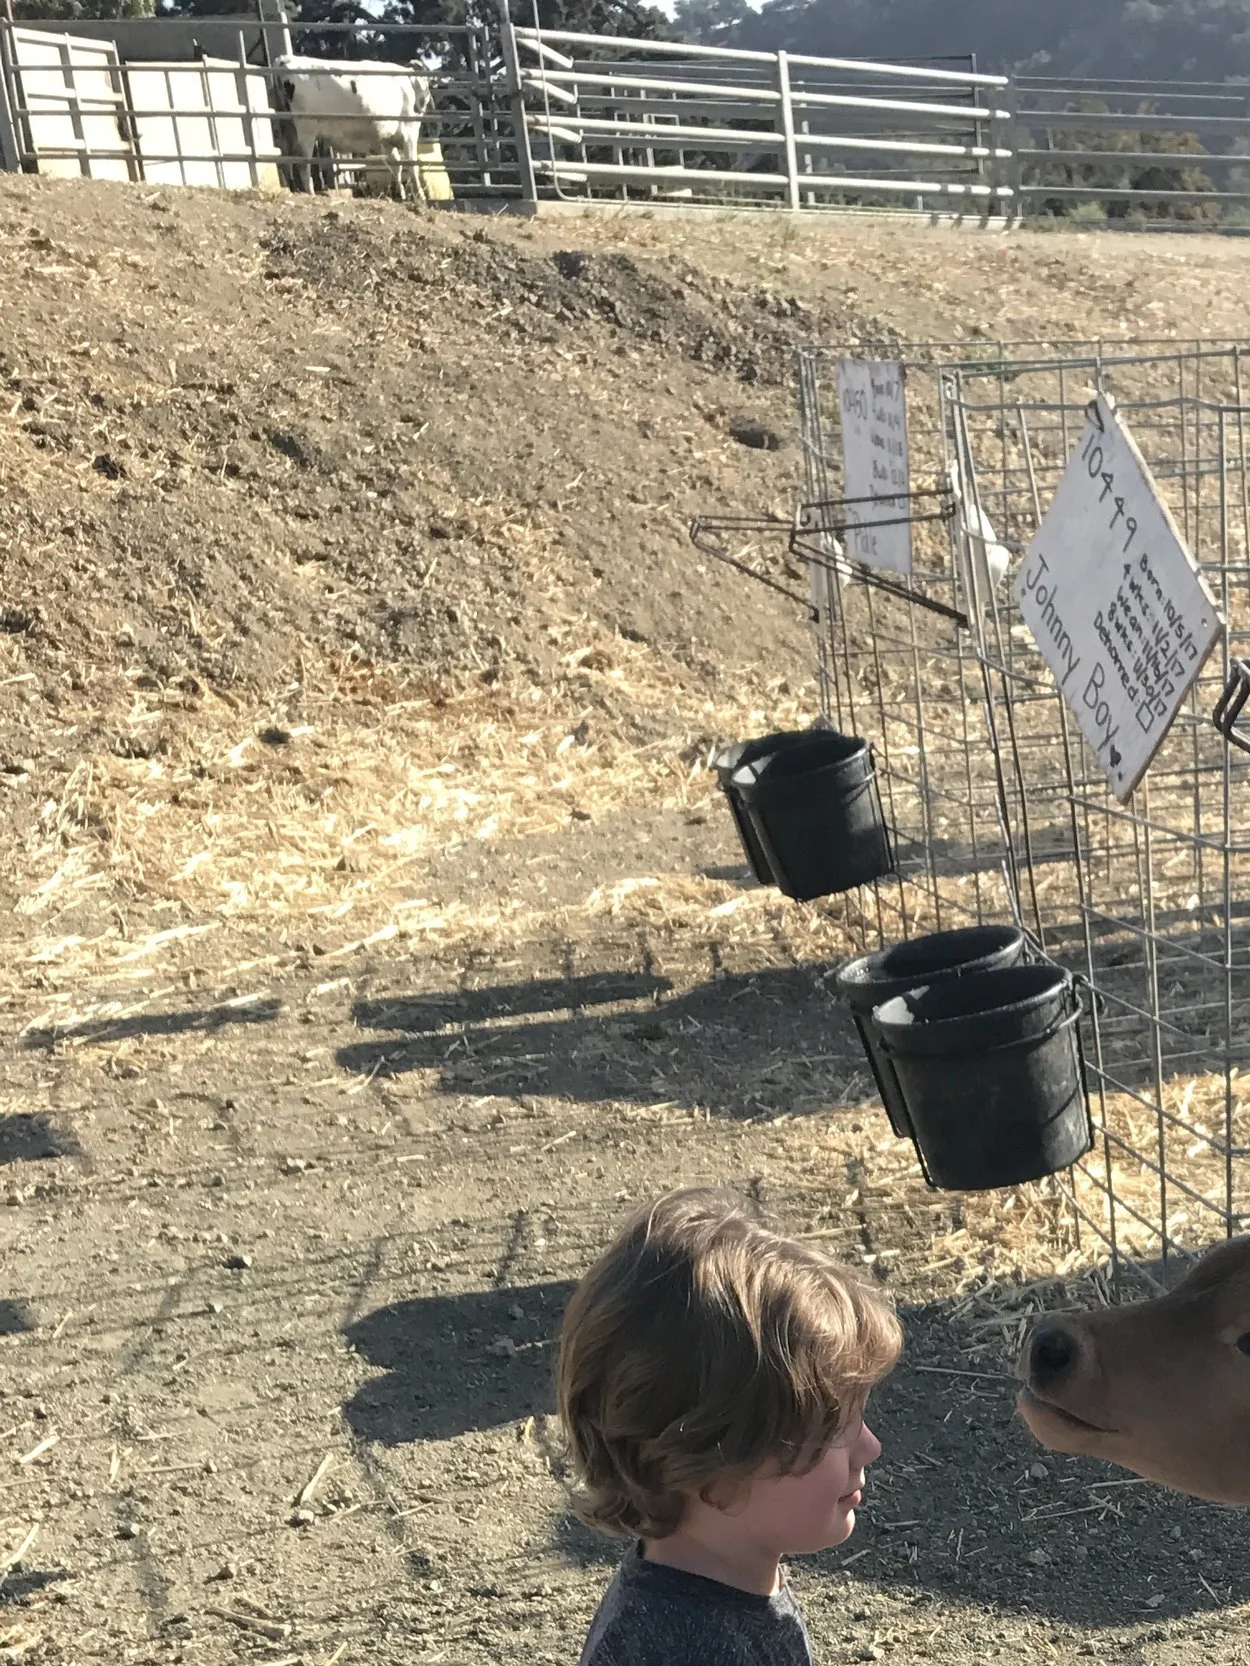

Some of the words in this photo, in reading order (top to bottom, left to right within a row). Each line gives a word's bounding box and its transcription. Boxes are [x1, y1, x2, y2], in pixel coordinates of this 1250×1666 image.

[1081, 432, 1137, 553] 10449
[1026, 553, 1081, 686] Johnny
[1082, 662, 1119, 752] Boy
